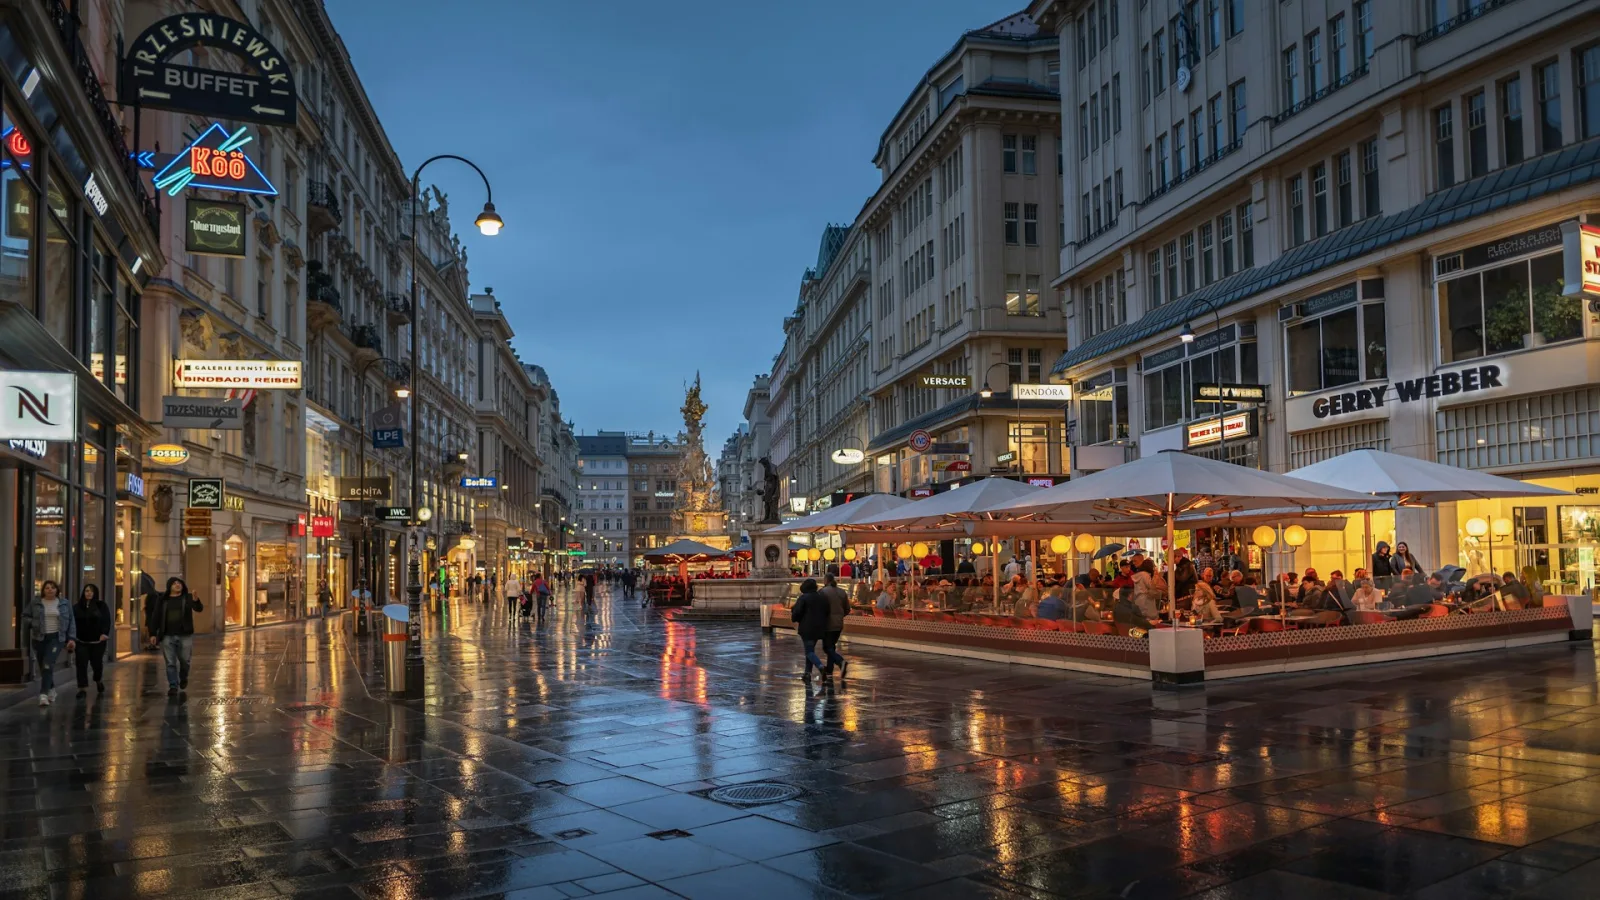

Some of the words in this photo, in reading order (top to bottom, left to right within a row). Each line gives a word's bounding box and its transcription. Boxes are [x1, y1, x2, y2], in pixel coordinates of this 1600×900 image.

[134, 16, 289, 95] TRZEŚNIEWSKI
[165, 67, 259, 97] BUFFET
[191, 147, 245, 179] Köö
[190, 220, 209, 231] blue
[1487, 239, 1518, 255] PLECH
[1527, 227, 1560, 242] PLECH
[923, 377, 967, 386] VERSACE
[1313, 385, 1388, 419] GERRY
[1394, 365, 1503, 403] WEBER
[377, 430, 399, 440] LPE
[465, 478, 493, 487] Berlitz
[390, 508, 406, 516] IWC
